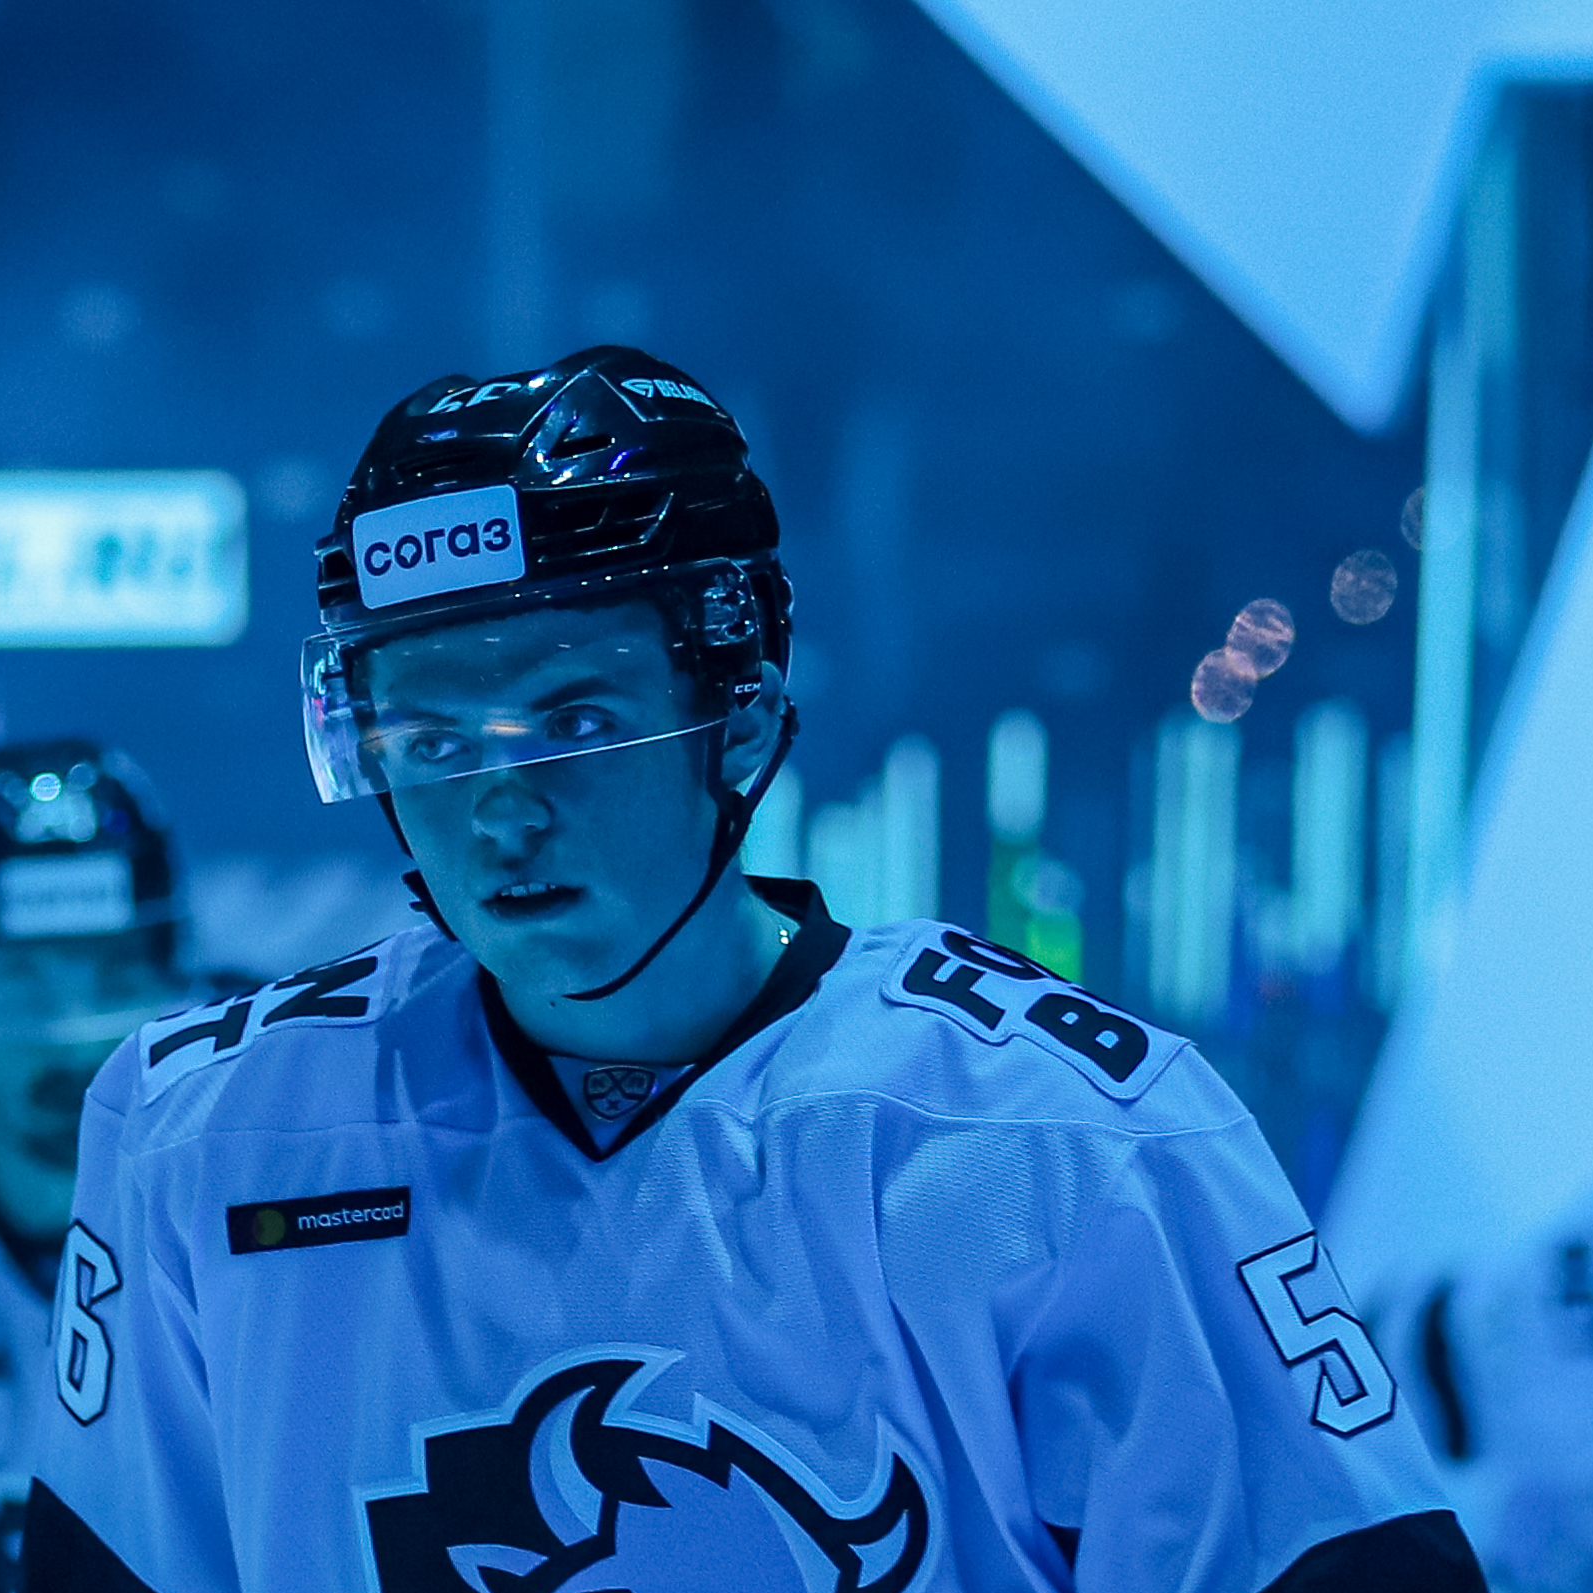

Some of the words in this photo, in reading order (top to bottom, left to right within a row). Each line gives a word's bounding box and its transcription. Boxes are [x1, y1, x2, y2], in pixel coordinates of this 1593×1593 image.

[363, 517, 513, 577] согаз
[734, 682, 761, 694] CCM
[298, 1200, 404, 1231] mastercad
